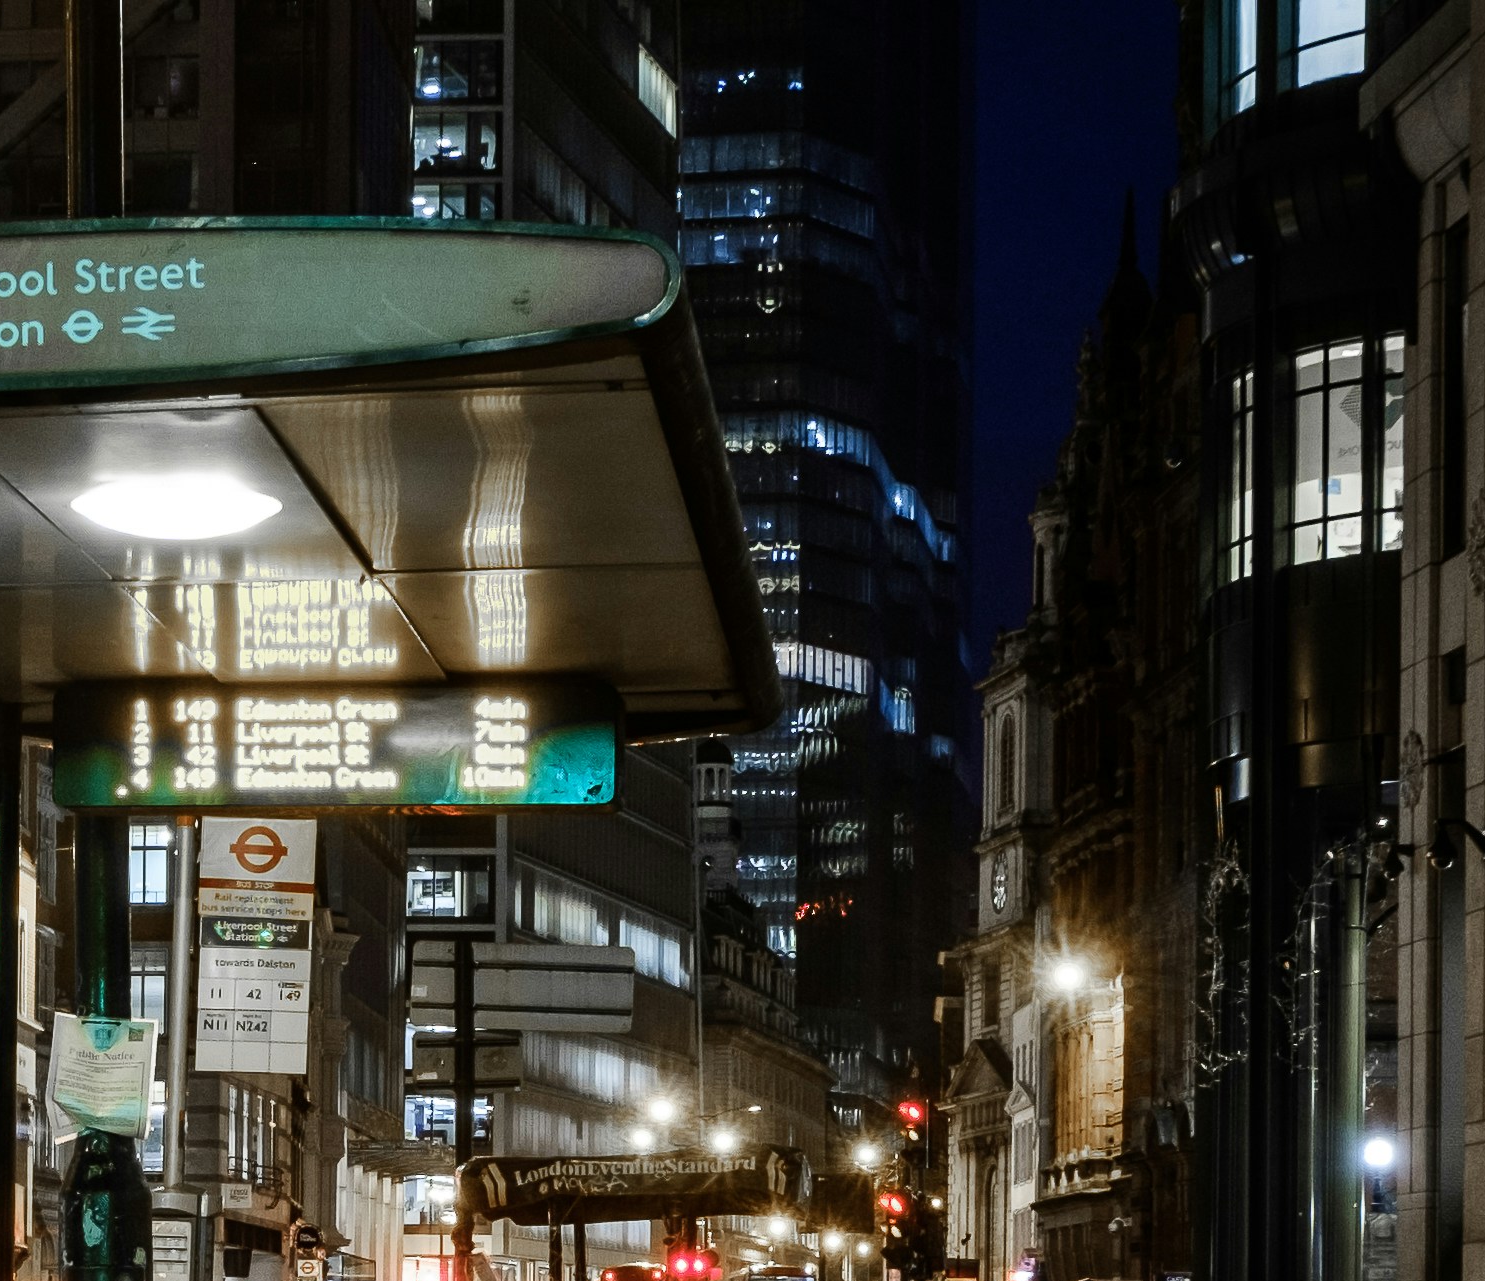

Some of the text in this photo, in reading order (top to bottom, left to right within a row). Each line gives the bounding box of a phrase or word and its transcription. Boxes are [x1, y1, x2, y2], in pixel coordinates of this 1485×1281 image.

[75, 257, 206, 294] Street
[134, 698, 526, 721] 1 149 Edmonton Green 4min
[133, 721, 526, 747] 2 11 Liverpool St 7min
[134, 746, 150, 766] 3
[185, 746, 217, 766] 42
[236, 745, 339, 772] Liverpool
[345, 744, 370, 766] St
[132, 767, 526, 790] 4 149 Edmonton Green 10min
[236, 880, 275, 890] BUS STOP
[215, 892, 295, 905] Rail replacement
[201, 903, 307, 917] bus service stops here
[216, 920, 298, 933] Liverpool Street
[224, 931, 261, 942] Station
[215, 957, 296, 970] towards Dalston
[210, 987, 222, 999] 11
[246, 988, 262, 1000] 42
[279, 988, 301, 1001] 149
[203, 1019, 228, 1031] N11
[235, 1020, 268, 1033] N242
